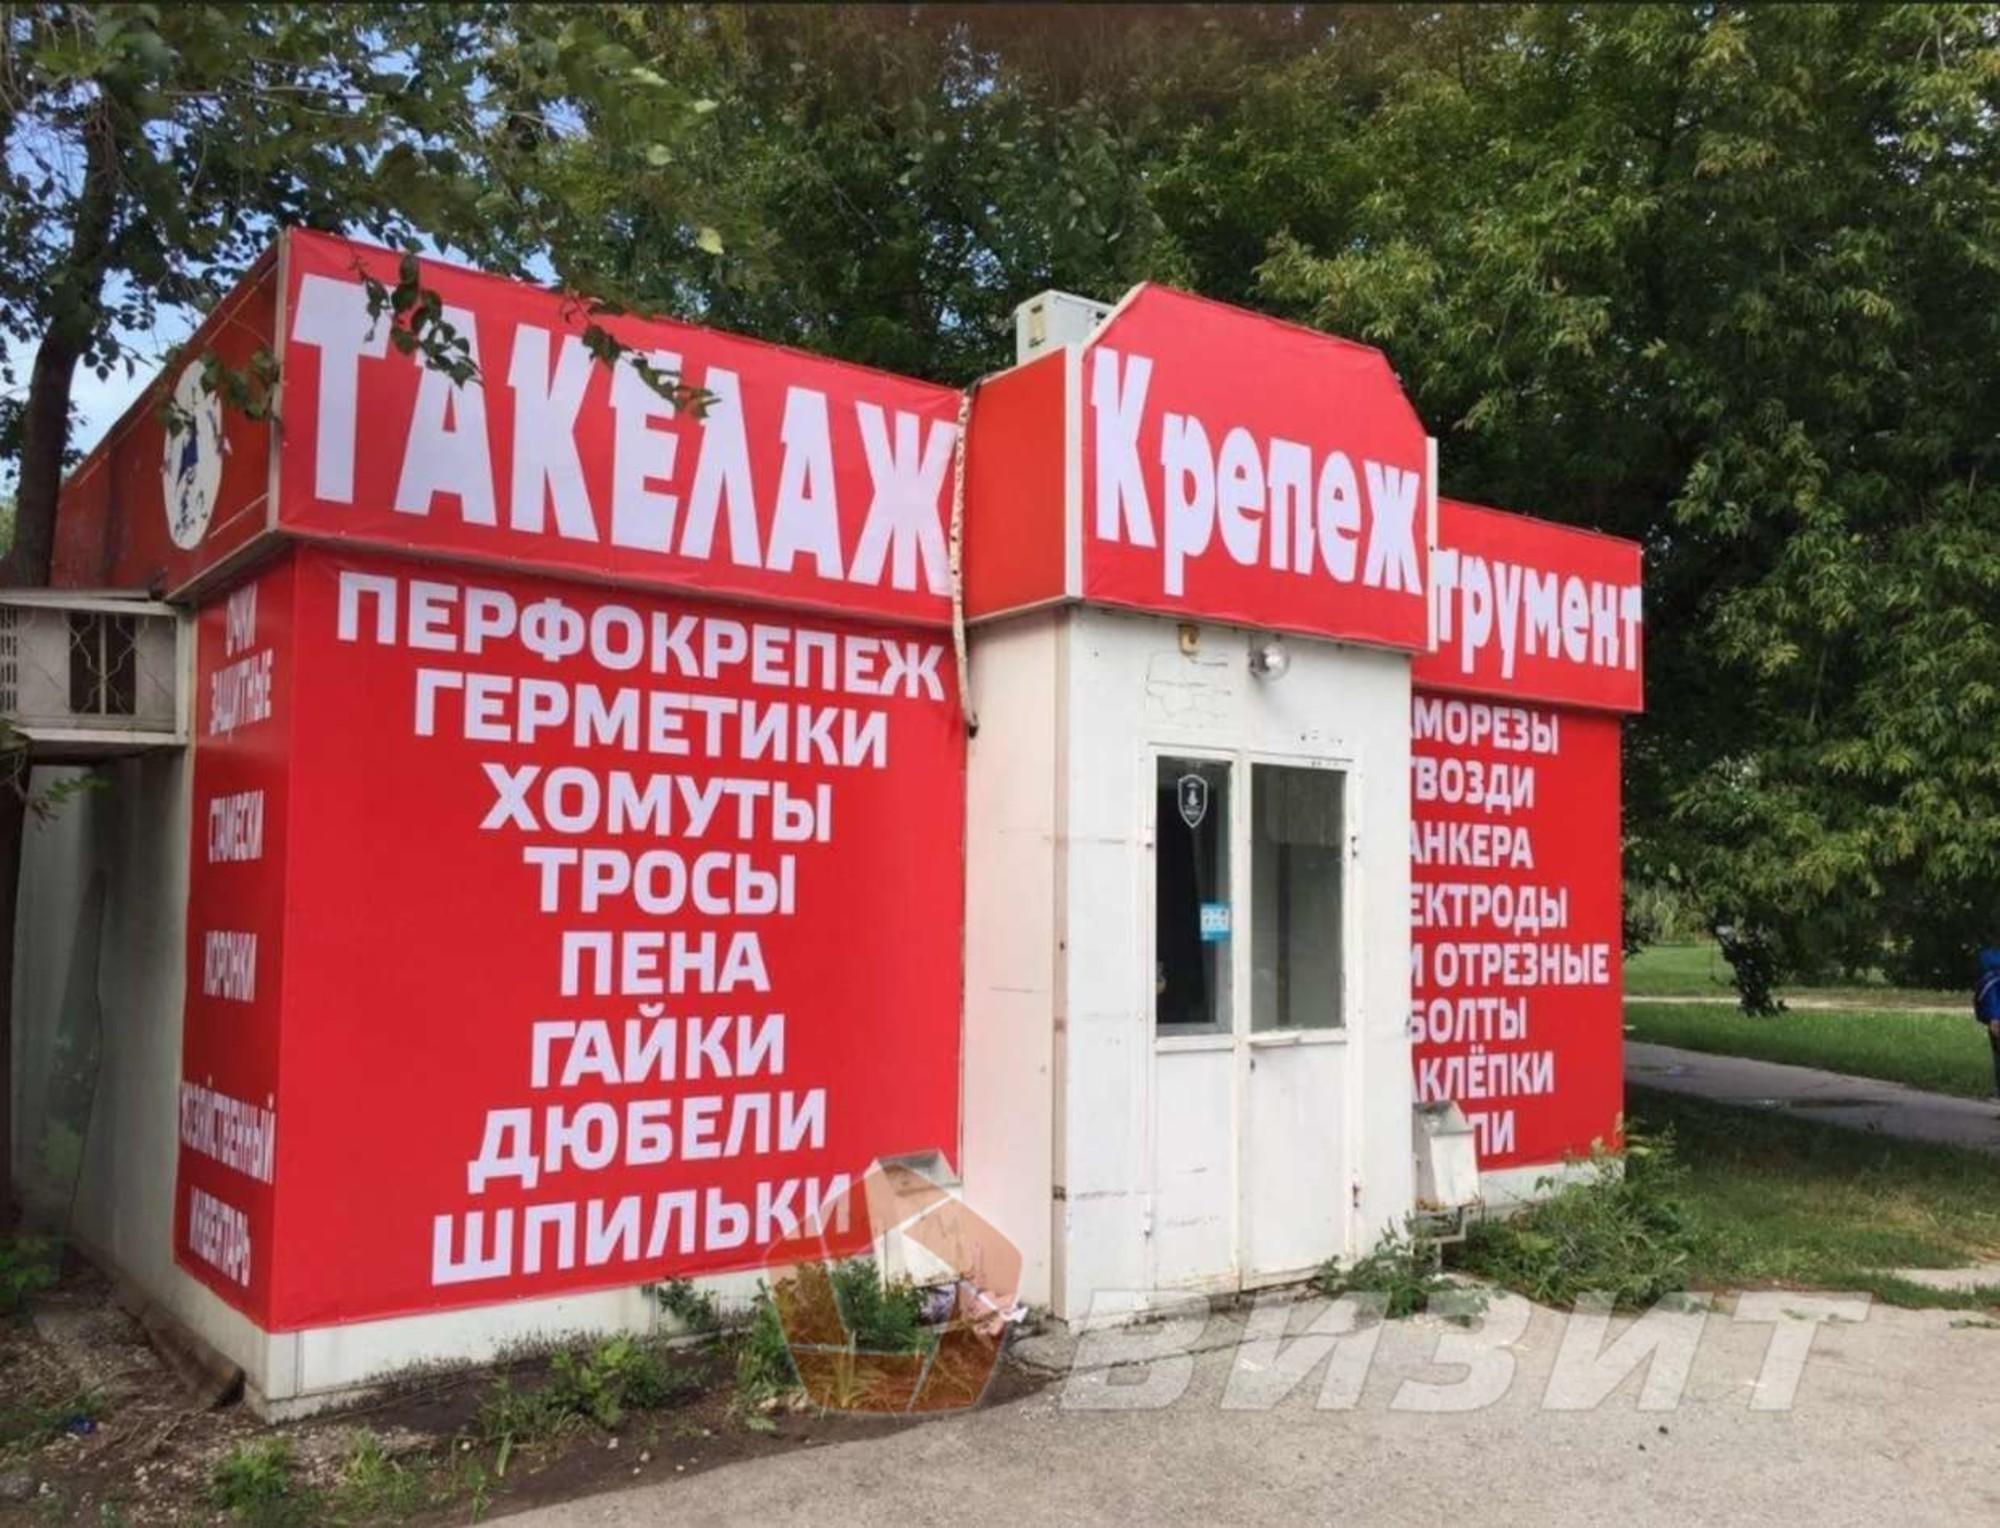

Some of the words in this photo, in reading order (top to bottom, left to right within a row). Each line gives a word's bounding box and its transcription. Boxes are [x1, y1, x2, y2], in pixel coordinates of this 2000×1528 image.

[292, 273, 957, 597] ТАКЕЛАЖ
[1091, 346, 1422, 597] Крепеж
[337, 571, 945, 702] ПЕРФОКРЕПЕЖ
[415, 668, 888, 770] ГЕРМЕТИКИ
[1411, 697, 1559, 755] МОРЕЗЫ
[478, 763, 832, 843] ХОМУТЫ
[1411, 755, 1535, 815] ВОЗДИ
[522, 846, 796, 916] ТРОСЫ
[560, 931, 771, 996] ПЕНА
[1434, 942, 1610, 987] ОТРЕЗНЫЕ
[530, 1002, 786, 1089] ГАЙКИ
[467, 1088, 827, 1195] ДЮБЕЛИ
[430, 1173, 851, 1287] ШПИЛЬКИ
